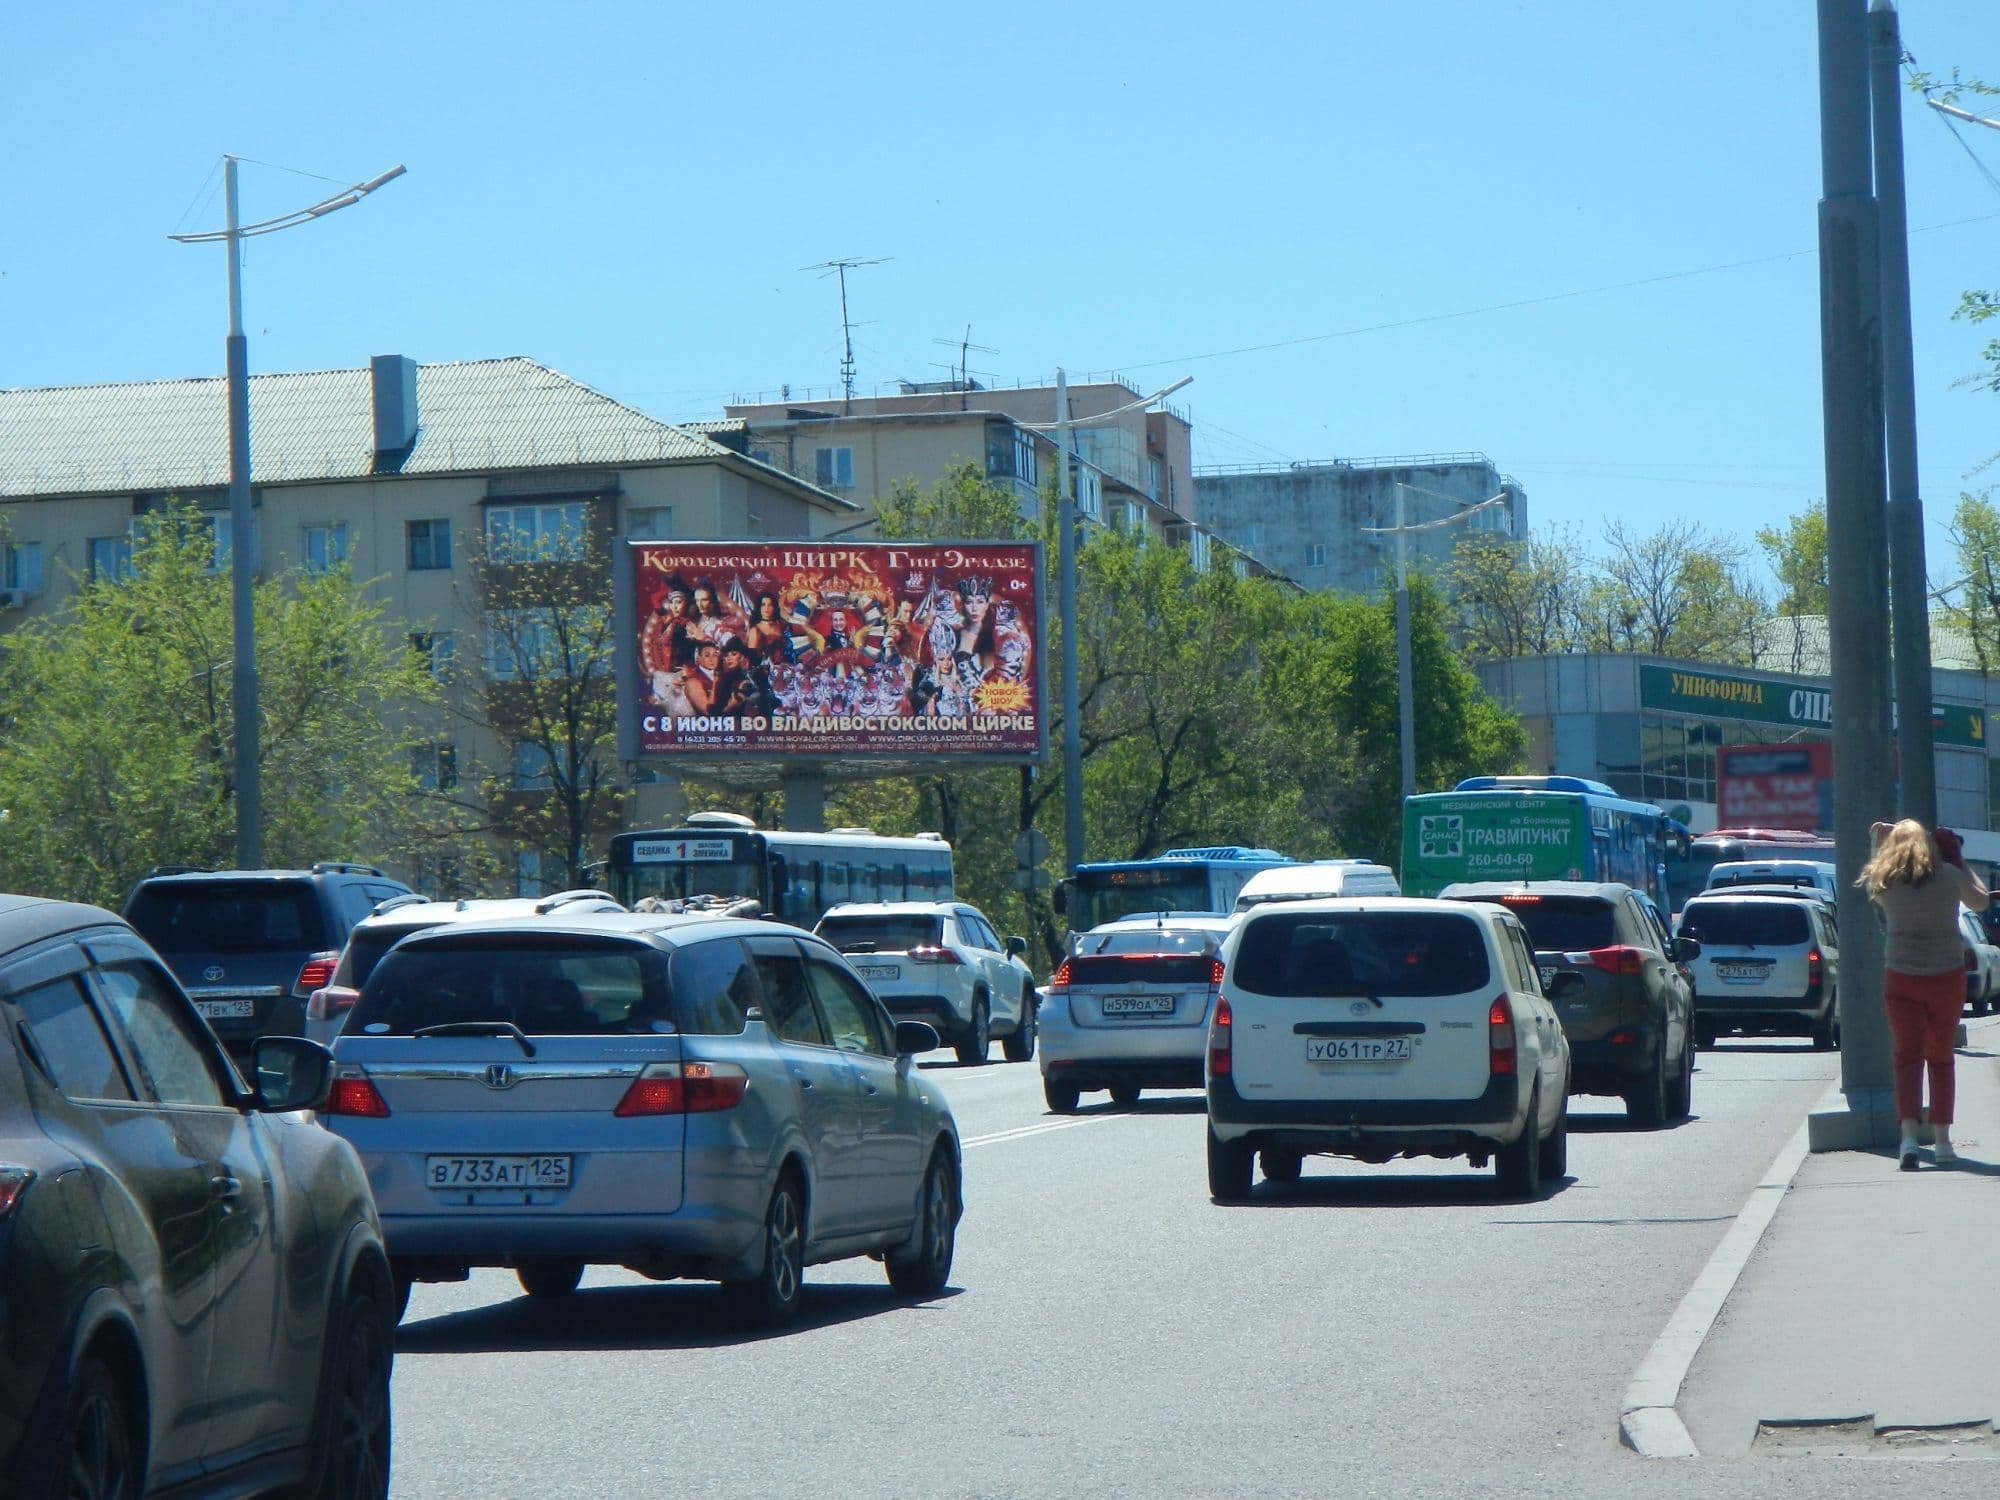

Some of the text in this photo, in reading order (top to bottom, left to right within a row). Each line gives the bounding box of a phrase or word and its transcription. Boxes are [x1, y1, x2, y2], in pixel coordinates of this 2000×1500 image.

[784, 551, 877, 573] ЦИРК
[1010, 580, 1027, 590] 0+
[1672, 673, 1762, 704] УНИФОРМА
[643, 716, 1035, 734] С 8 ИЮНЯ ВО ВЛАДИВОСТОКСКОМ ЦИРКЕ
[1441, 800, 1546, 811] МЕДИЦИНСКИЙ ЦЕНТР
[1466, 829, 1571, 846] ТРАВМПУНКТ
[677, 842, 687, 859] 1
[1468, 854, 1533, 866] 260-60-60
[1315, 1040, 1404, 1058] У061ТР 27
[435, 1159, 565, 1183] В733АТ 125
